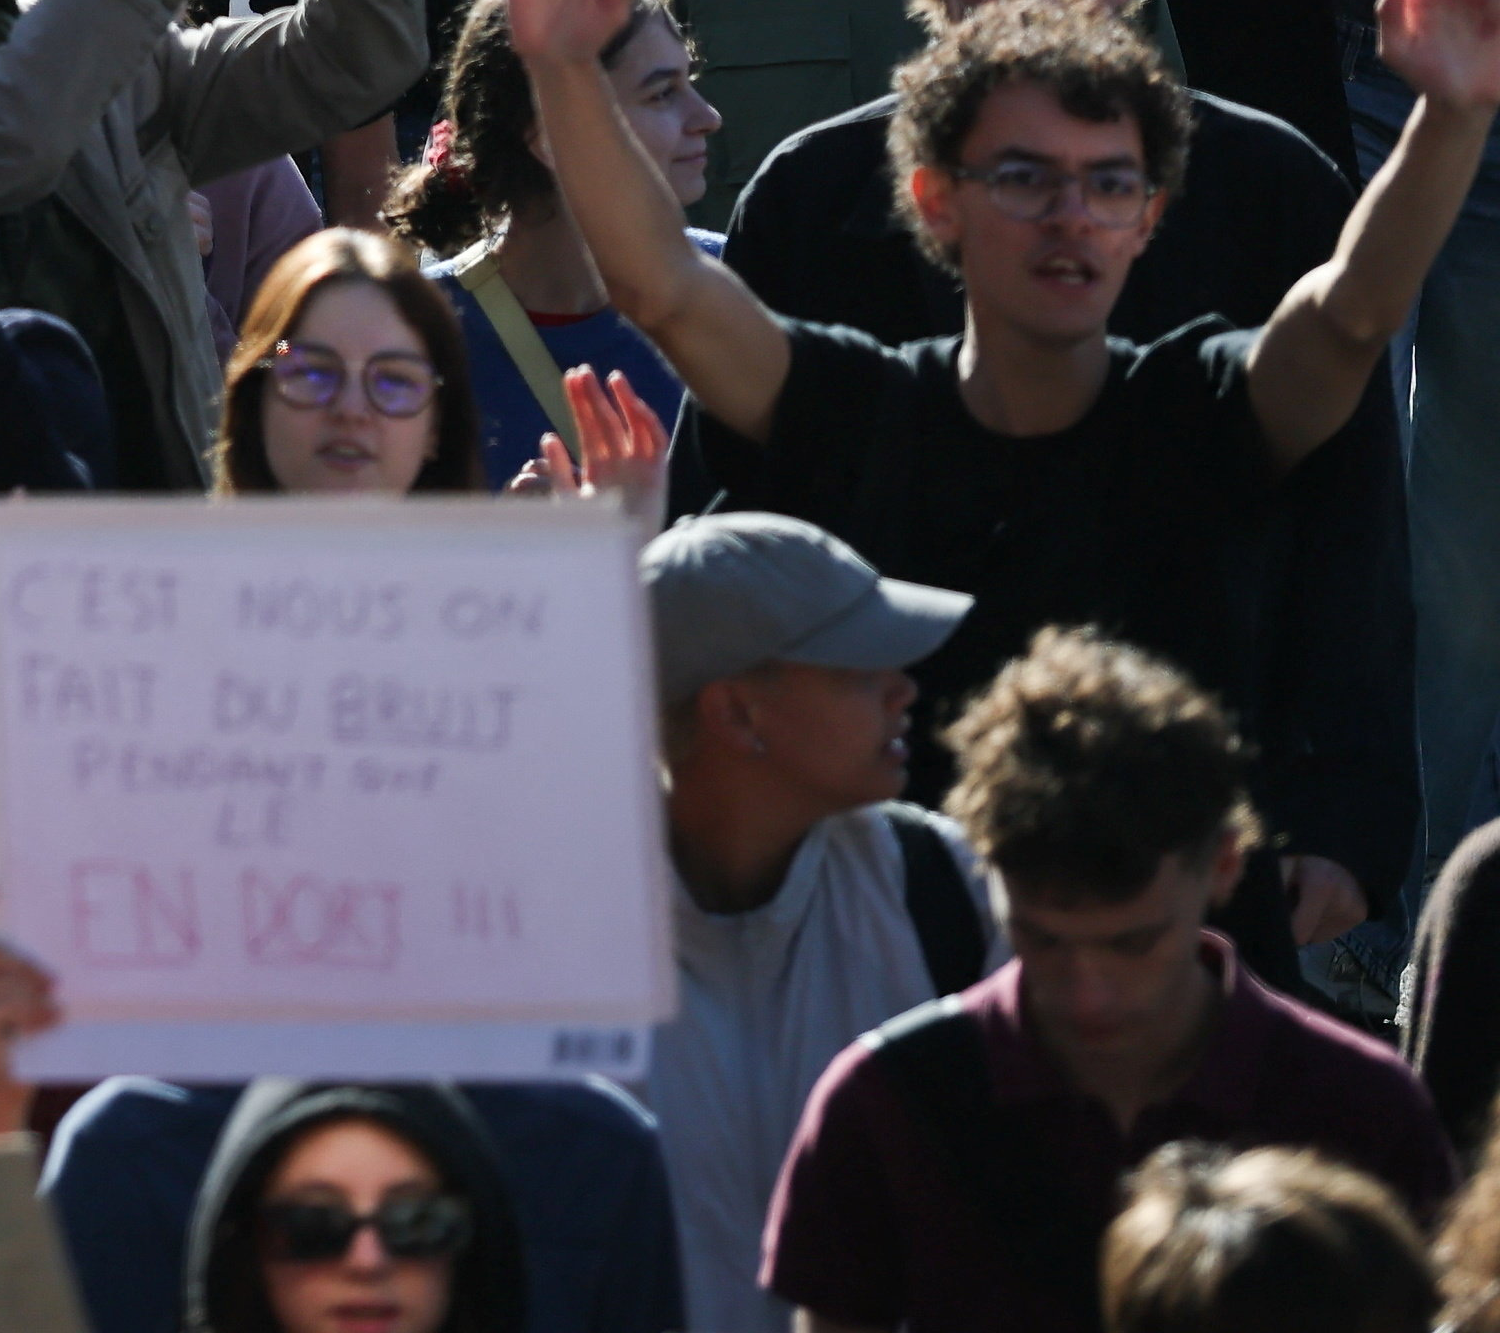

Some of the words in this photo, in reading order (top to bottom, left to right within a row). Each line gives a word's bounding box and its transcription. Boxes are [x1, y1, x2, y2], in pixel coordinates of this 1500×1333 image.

[11, 558, 183, 638] C'EST
[236, 583, 409, 642] NOUS
[441, 588, 547, 640] ON
[18, 653, 156, 728] FAIT
[214, 671, 297, 735] DU
[329, 674, 524, 744] BRUIT
[74, 741, 327, 793] PENDANT
[216, 804, 290, 848] LE
